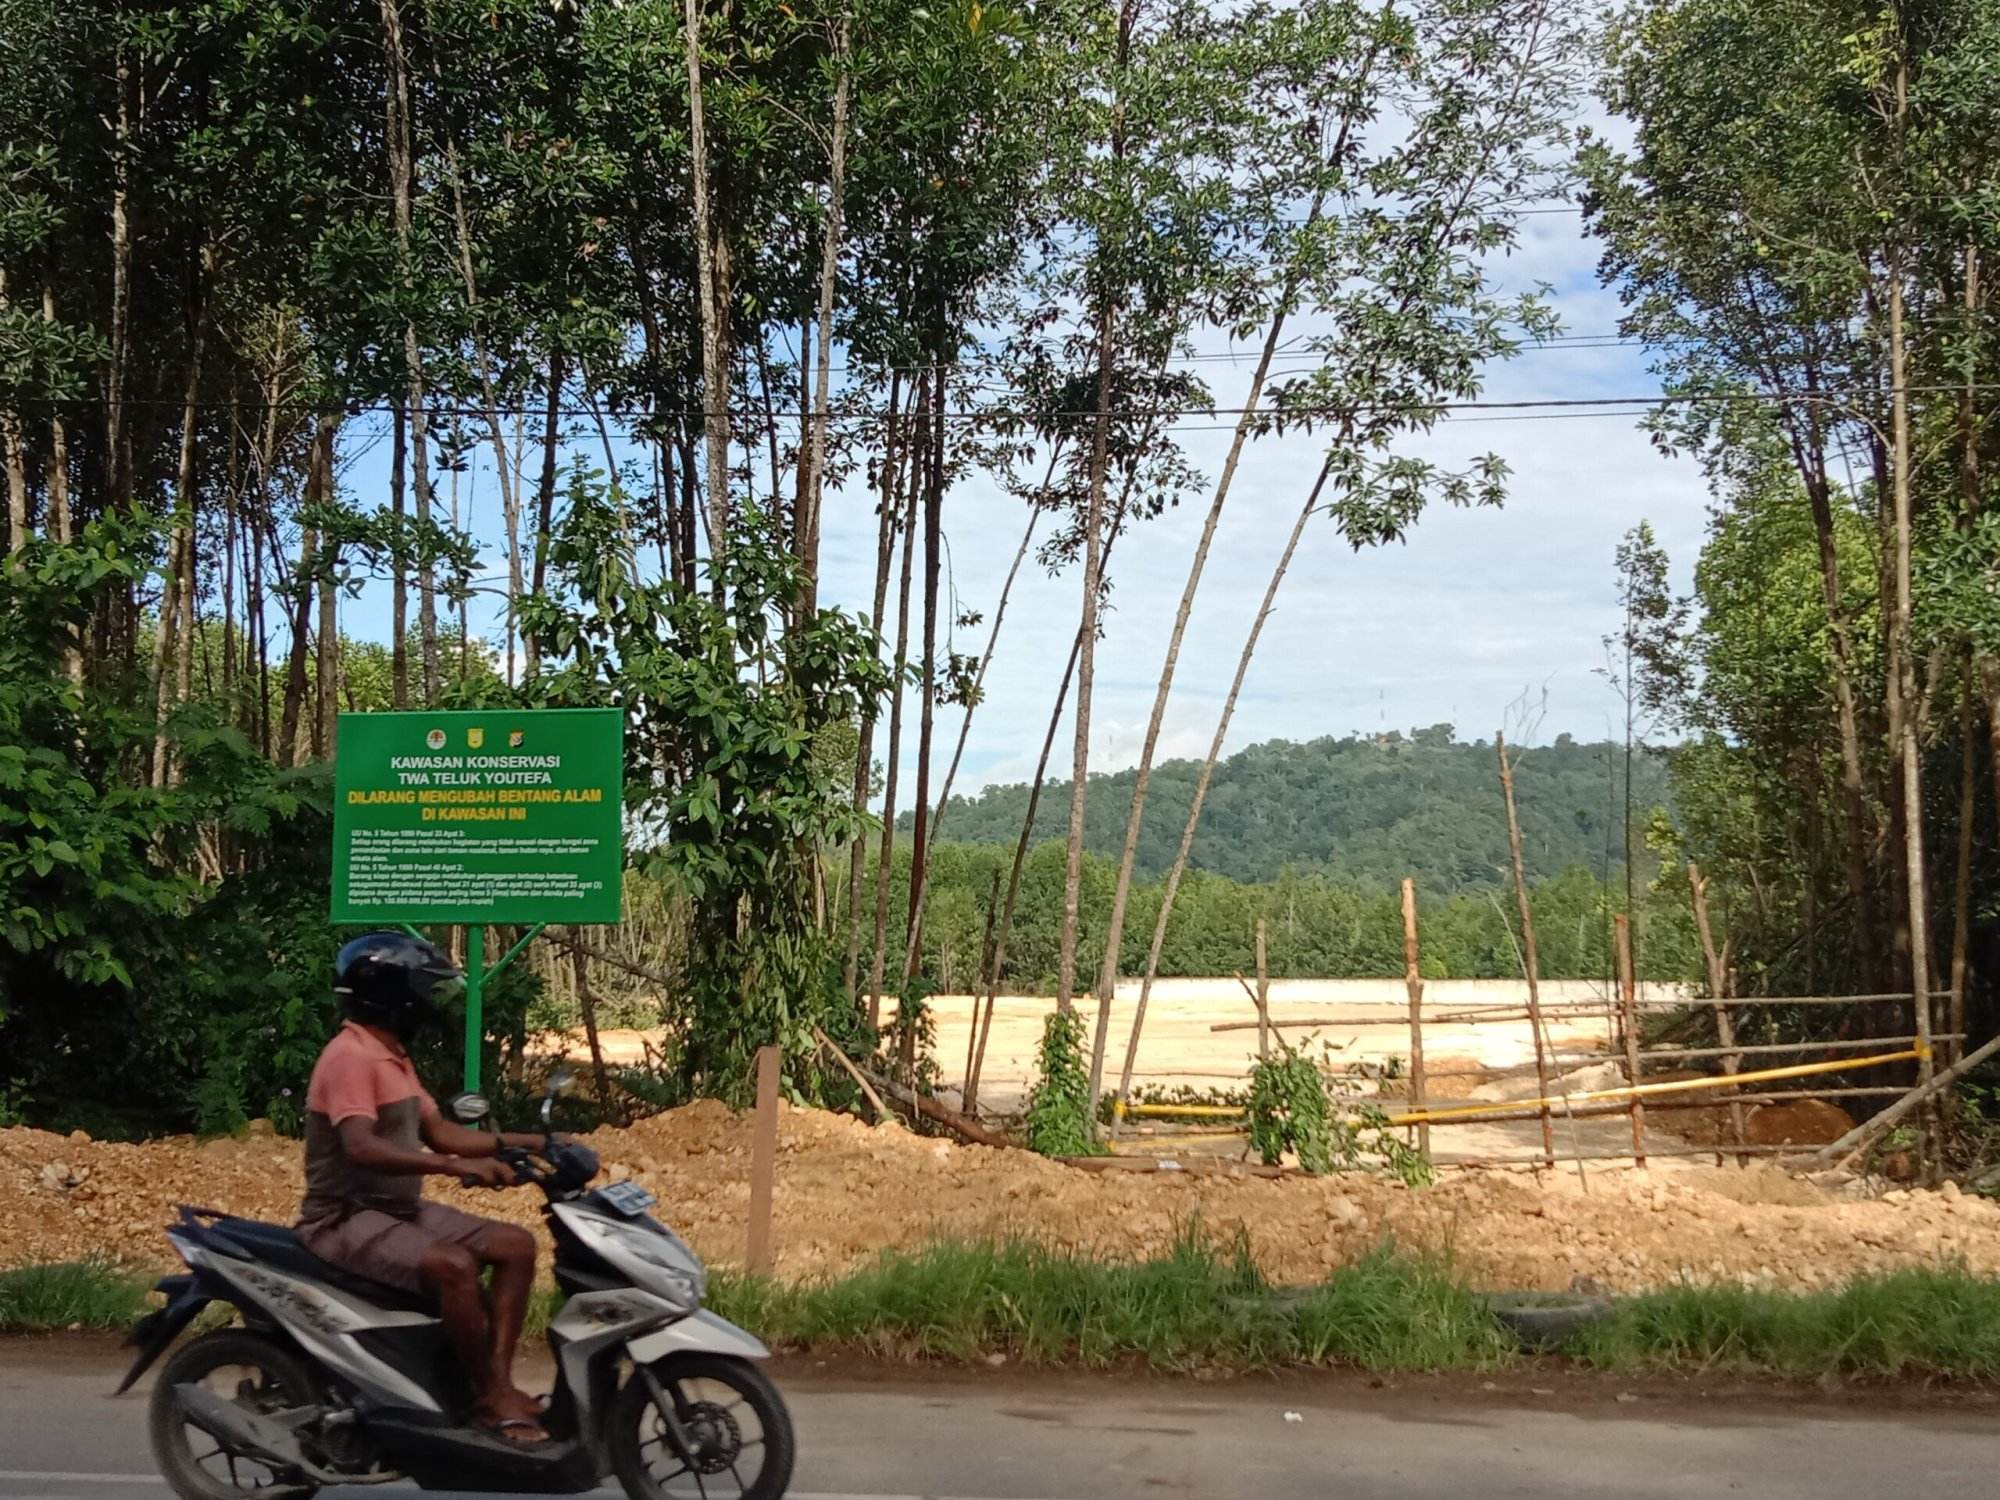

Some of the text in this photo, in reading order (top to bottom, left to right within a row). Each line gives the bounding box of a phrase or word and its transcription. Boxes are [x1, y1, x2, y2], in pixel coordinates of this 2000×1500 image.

[391, 755, 561, 769] KAWASAN KONSERVASI
[398, 771, 552, 785] TWA TELUK YOUTEFA
[348, 788, 602, 804] DILARANG MENGUBAH BENTANG ALAM
[422, 807, 527, 821] DI KAWASAN INI
